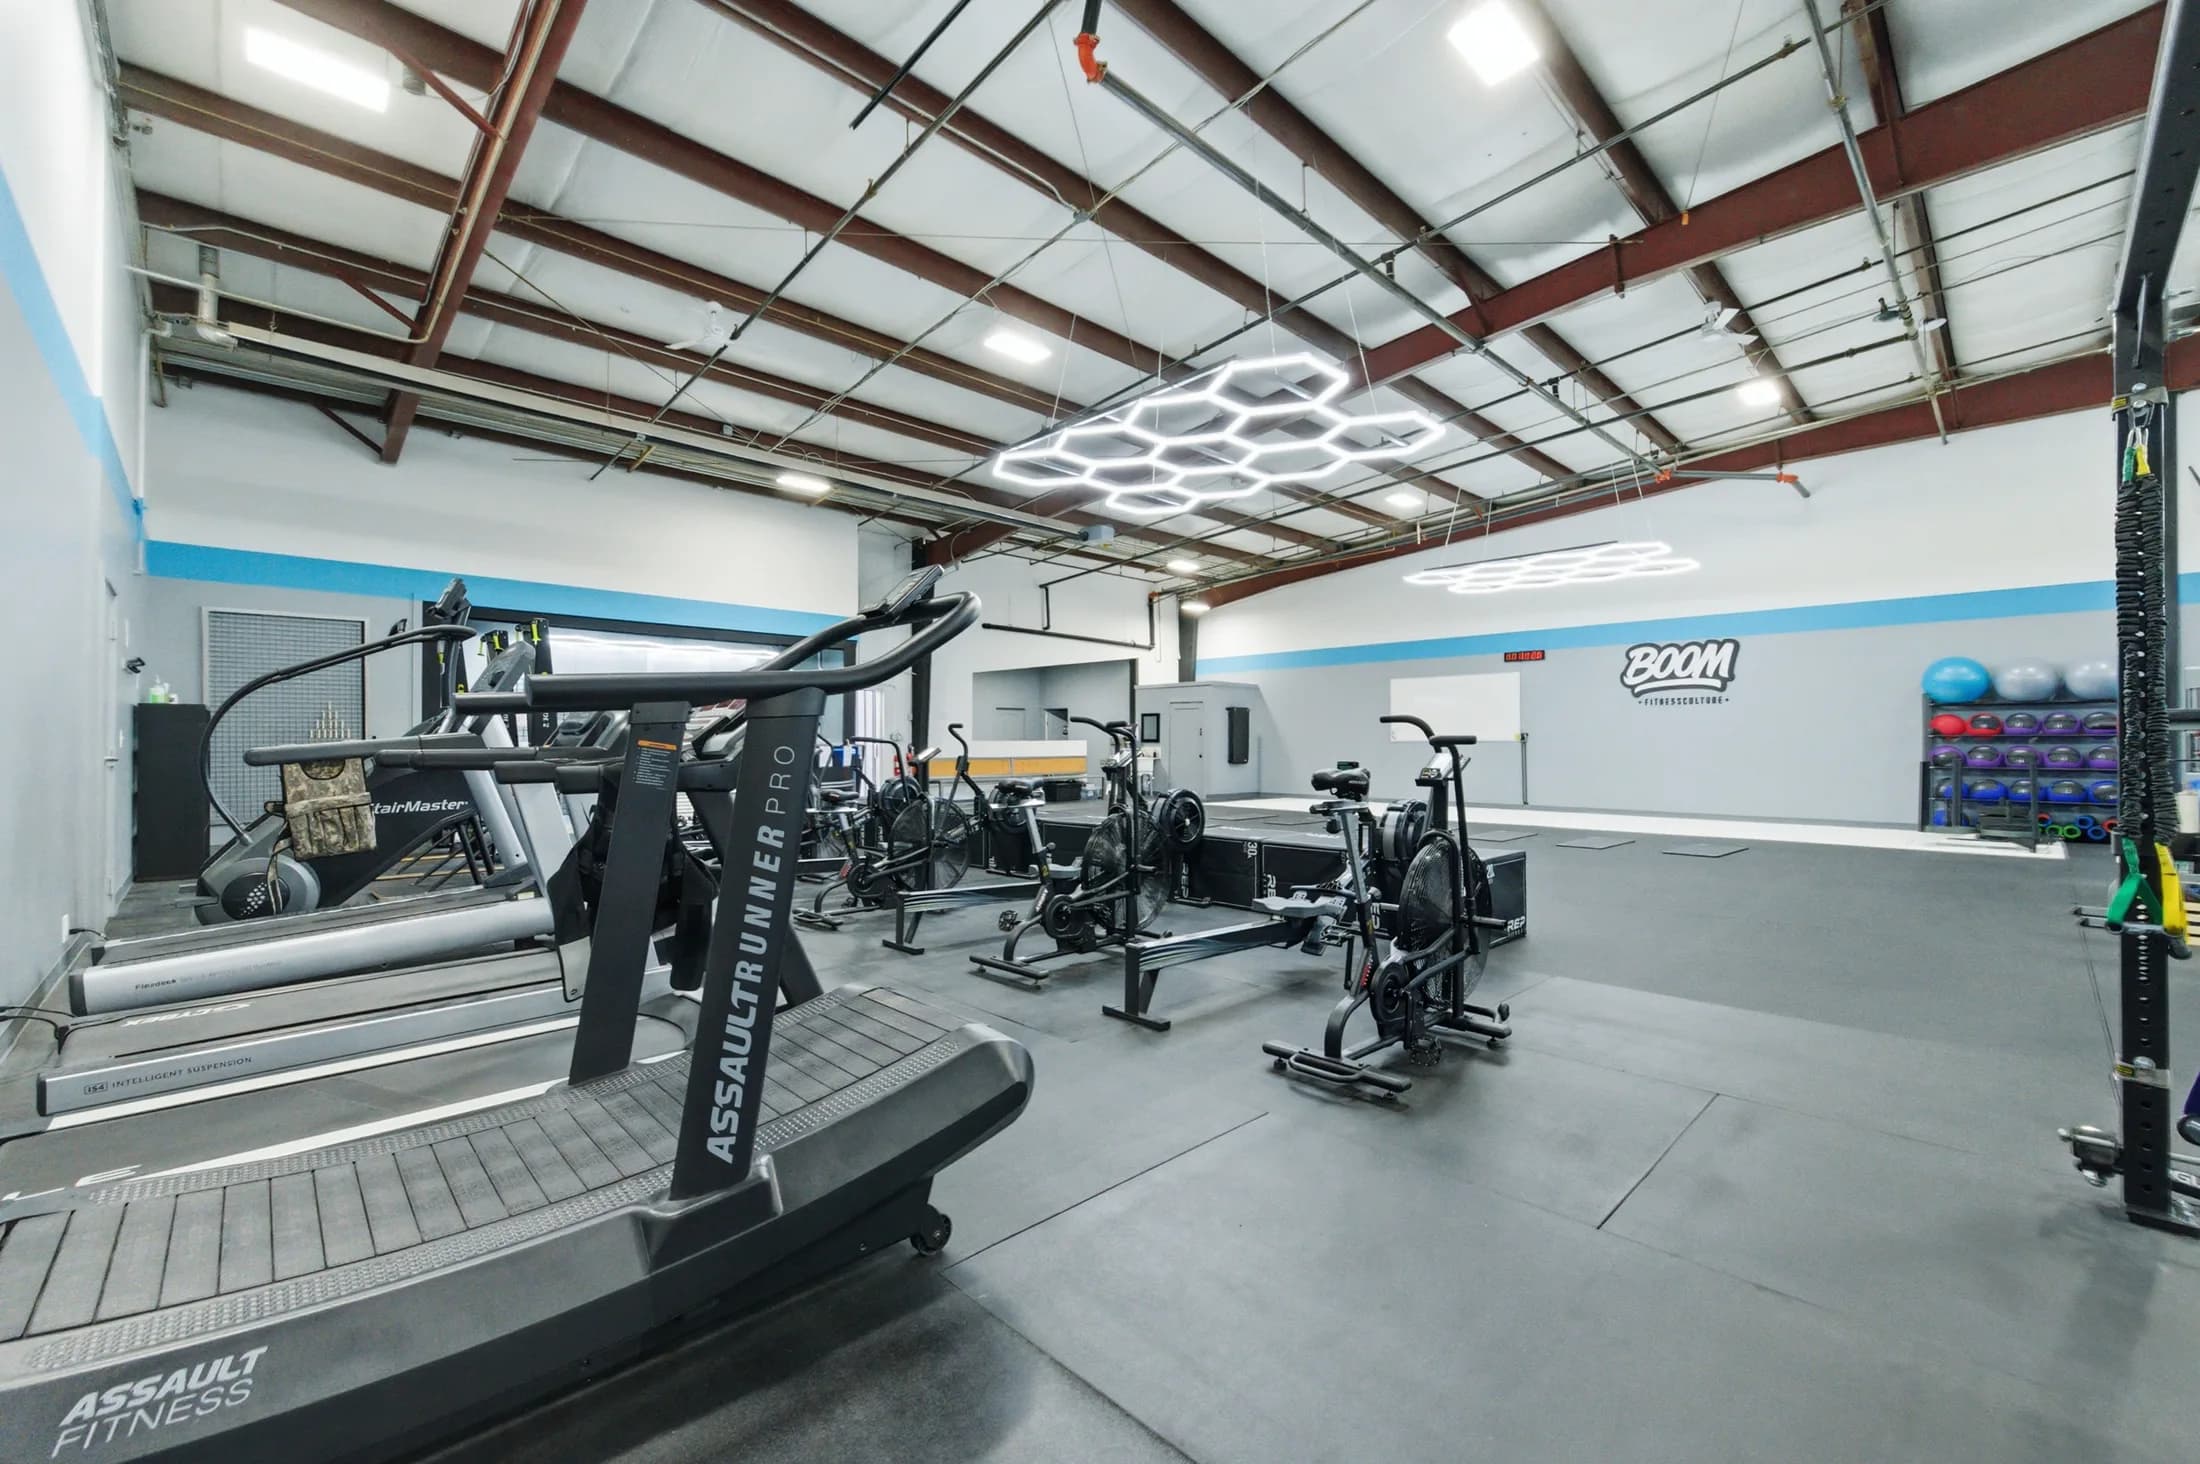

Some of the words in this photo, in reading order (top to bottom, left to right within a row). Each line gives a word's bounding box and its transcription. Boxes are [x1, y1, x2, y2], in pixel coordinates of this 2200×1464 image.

[1620, 639, 1740, 688] BOOM
[765, 744, 797, 815] PRO
[371, 799, 465, 815] tairMaster
[1266, 874, 1277, 897] RE
[1507, 915, 1526, 933] REP
[112, 1069, 184, 1089] INTELLIGENT
[187, 1056, 253, 1075] SUSPENSION
[57, 1345, 270, 1428] ASSAULT
[51, 1377, 254, 1460] FITNESS
